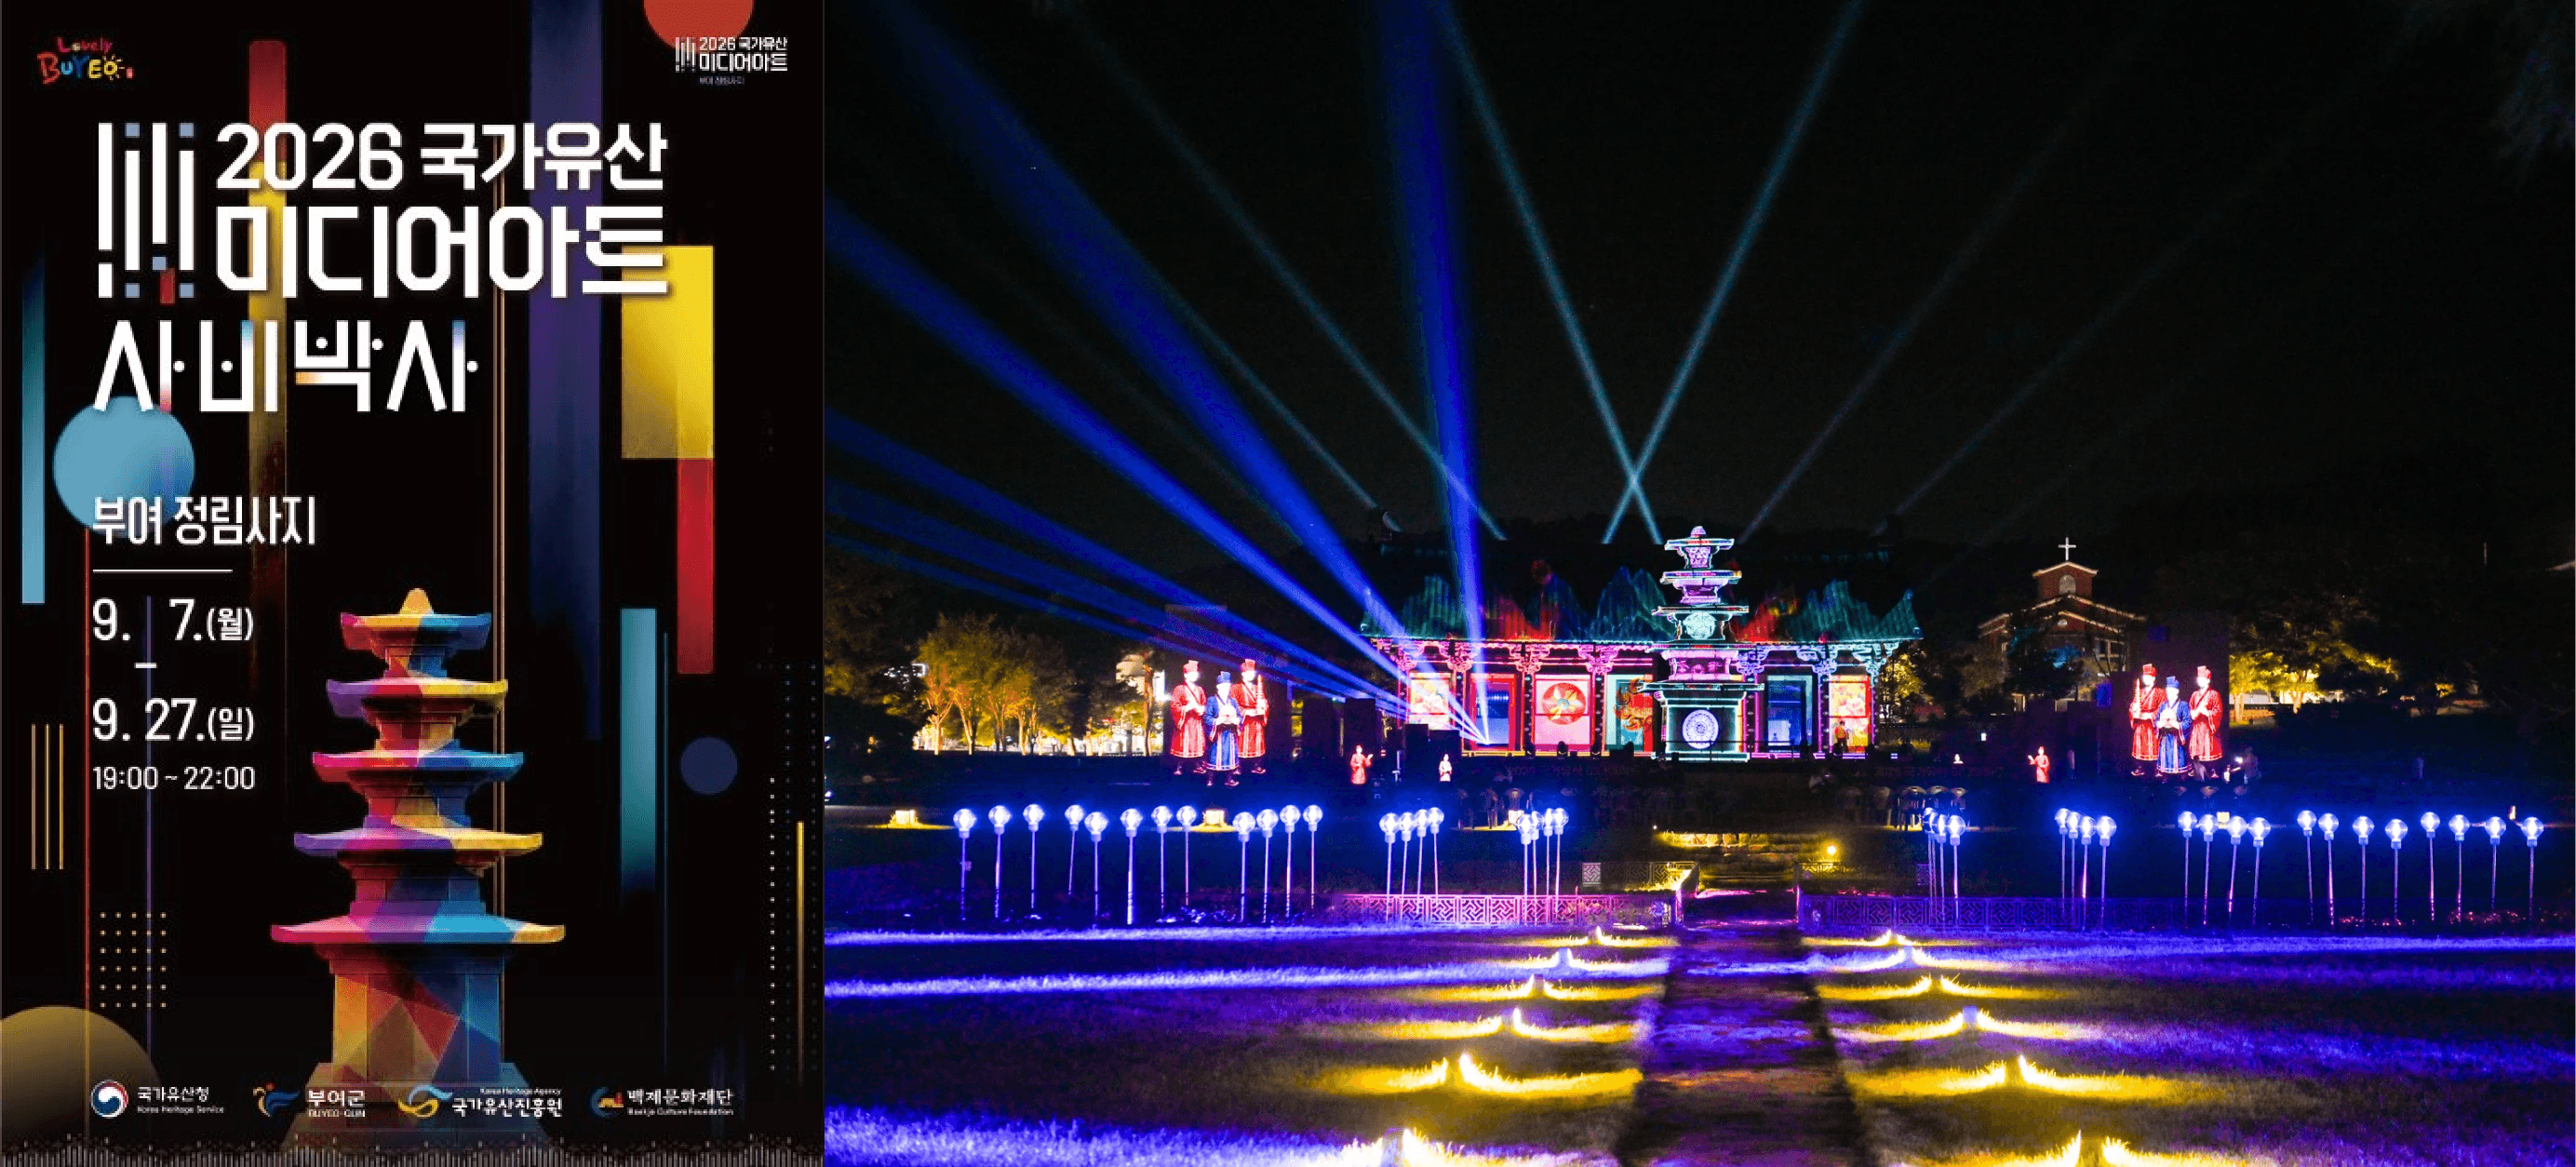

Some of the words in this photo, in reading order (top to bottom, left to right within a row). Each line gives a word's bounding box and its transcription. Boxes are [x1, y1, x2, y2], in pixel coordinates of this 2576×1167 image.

[700, 37, 735, 50] 2026
[739, 37, 787, 50] 국가유산
[699, 53, 788, 72] 미디어아트
[216, 123, 404, 190] 2026
[420, 123, 667, 190] 국가유산
[215, 206, 668, 298] 미디어아트
[93, 320, 478, 412] 사비박사
[93, 496, 163, 545] 부여
[174, 496, 315, 545] 정림사지
[92, 766, 158, 789] 19:00
[183, 766, 255, 789] 22:00
[137, 1086, 209, 1103] 국가유산청
[308, 1090, 366, 1108] 부여군
[626, 1088, 735, 1107] 백제문화재단
[451, 1097, 563, 1119] 국가유산진흥원
